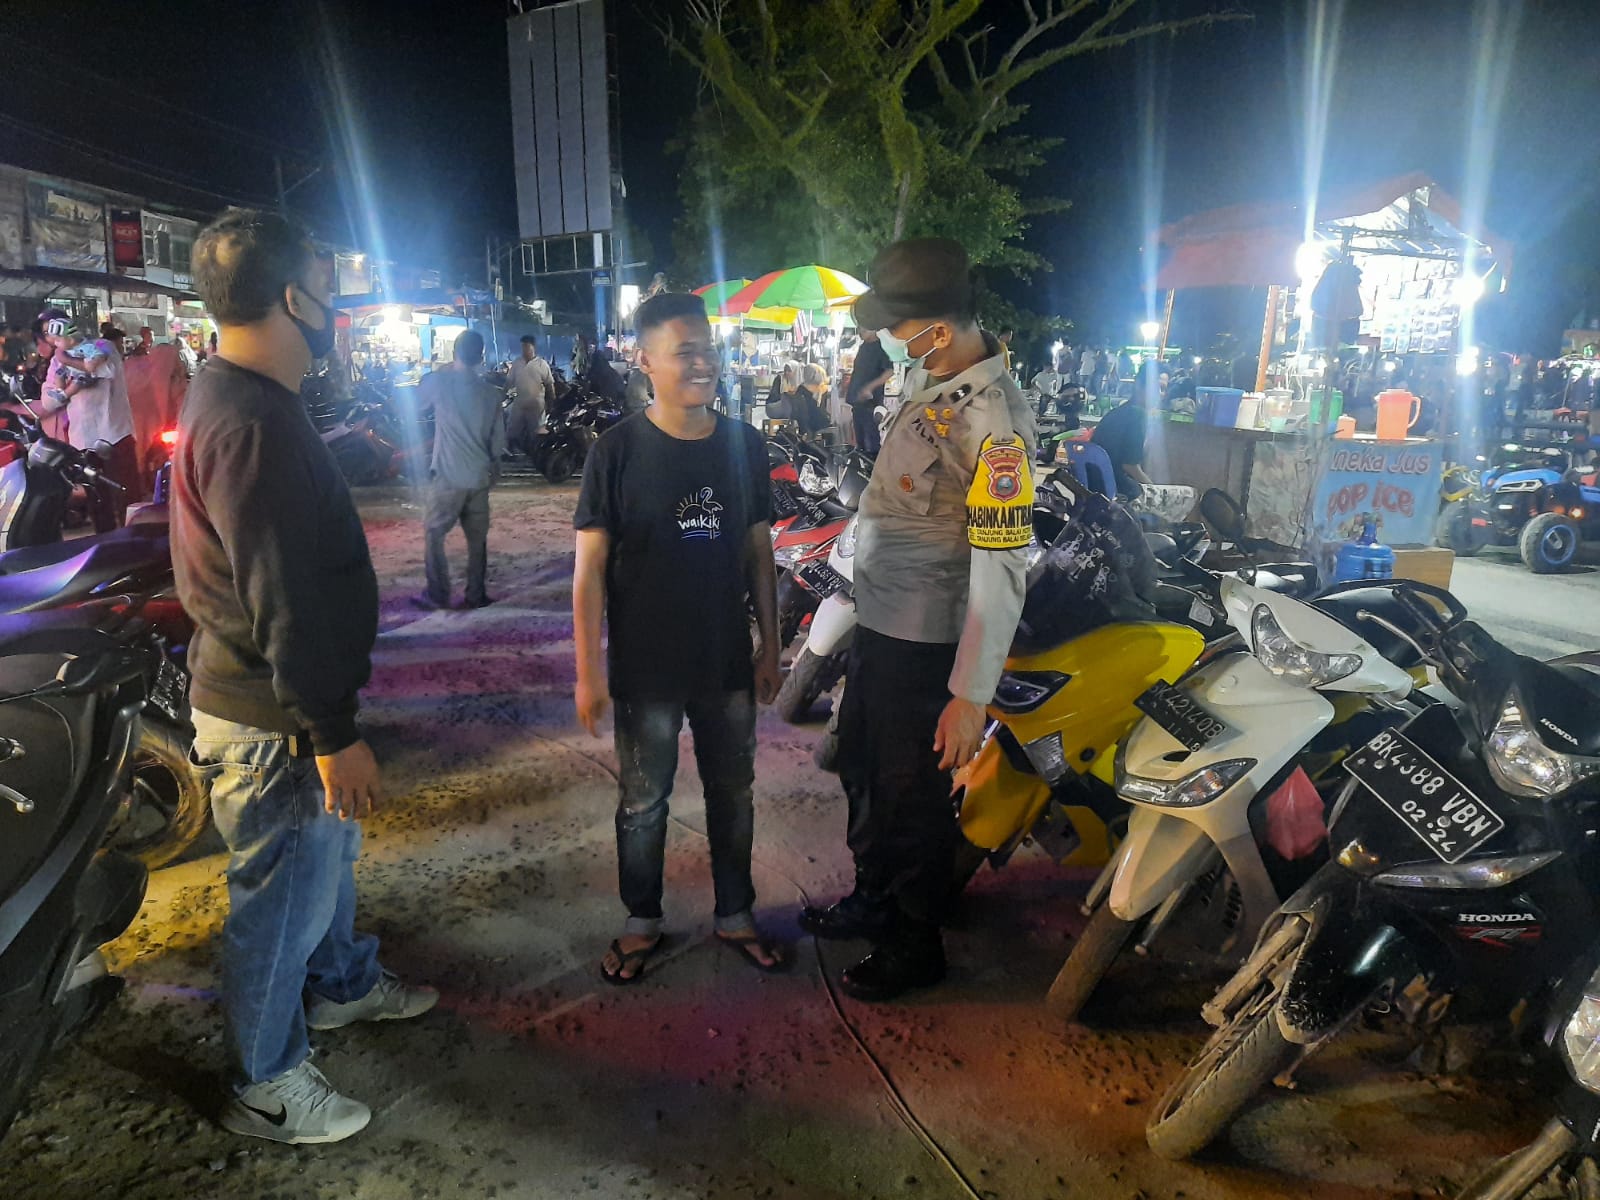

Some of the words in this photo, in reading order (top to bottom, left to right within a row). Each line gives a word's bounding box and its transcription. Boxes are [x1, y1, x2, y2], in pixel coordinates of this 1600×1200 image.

[678, 514, 720, 530] waikiki
[1540, 717, 1580, 746] HONDA
[1441, 791, 1492, 838] VBN
[1459, 912, 1537, 923] HONDA
